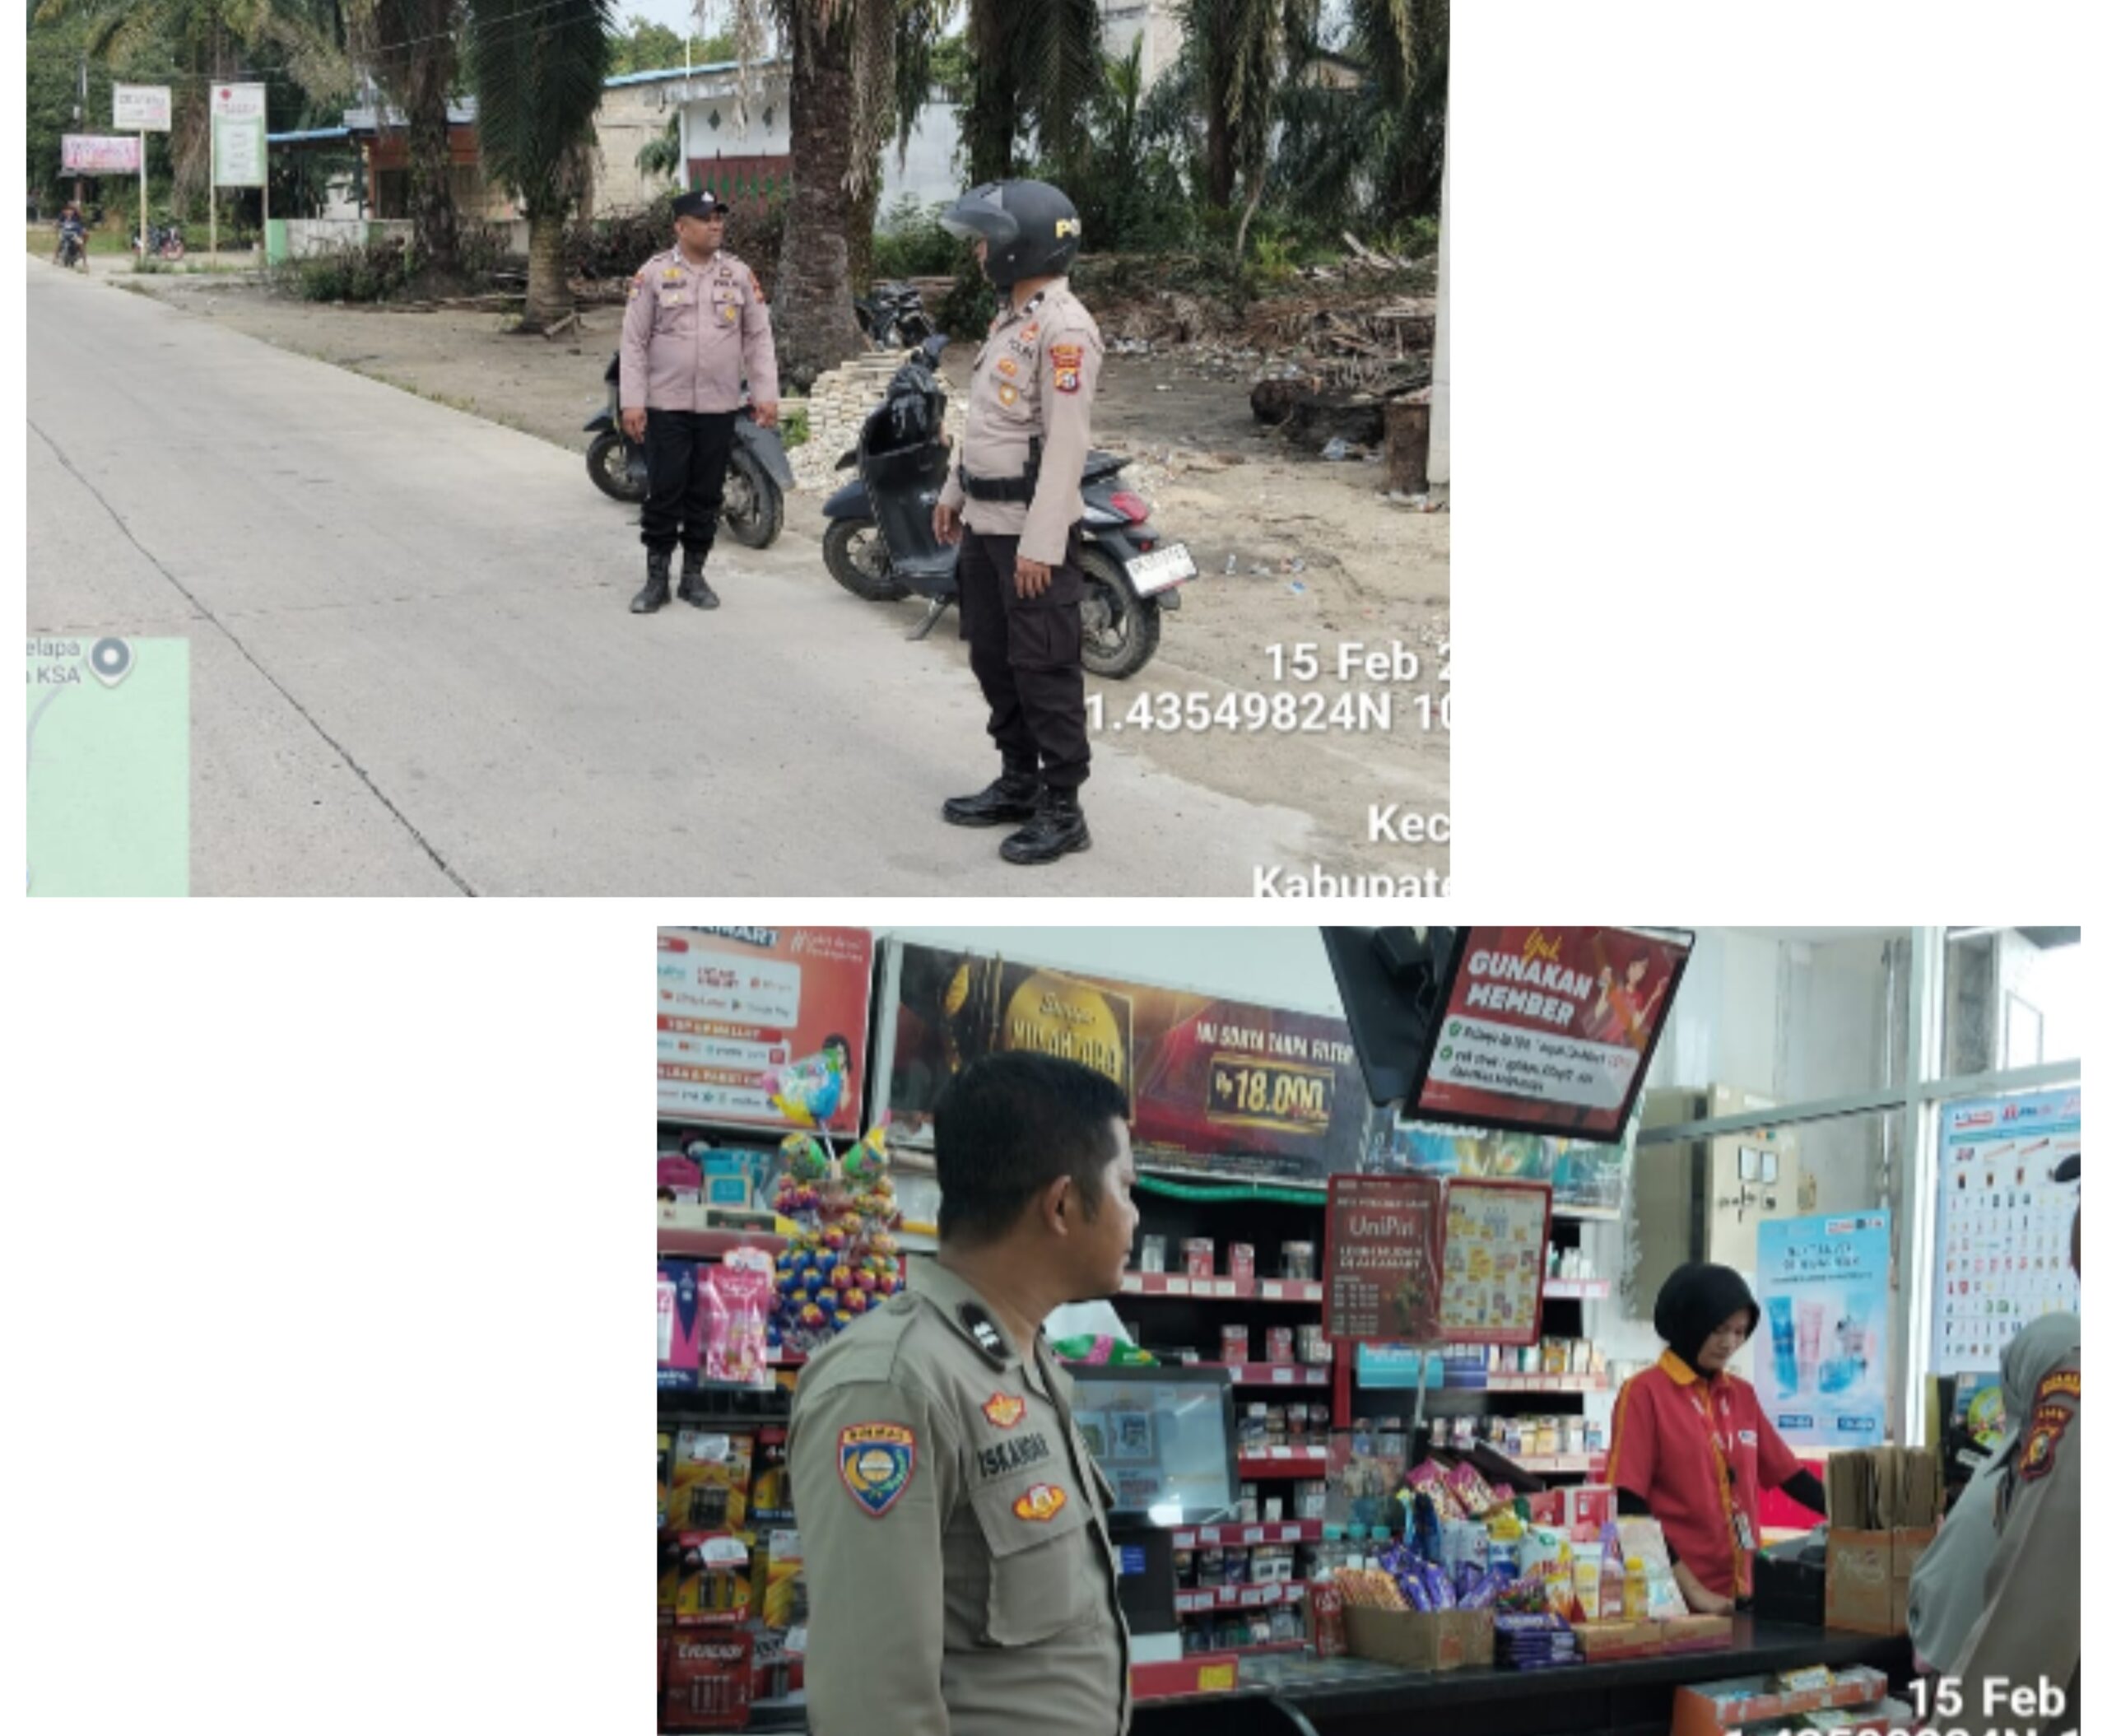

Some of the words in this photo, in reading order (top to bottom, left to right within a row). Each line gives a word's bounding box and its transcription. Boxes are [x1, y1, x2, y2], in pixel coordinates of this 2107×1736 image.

[1467, 949, 1594, 1001] GUNAKAN
[1465, 983, 1575, 1029] MEMBER
[1348, 1214, 1415, 1238] UniPin
